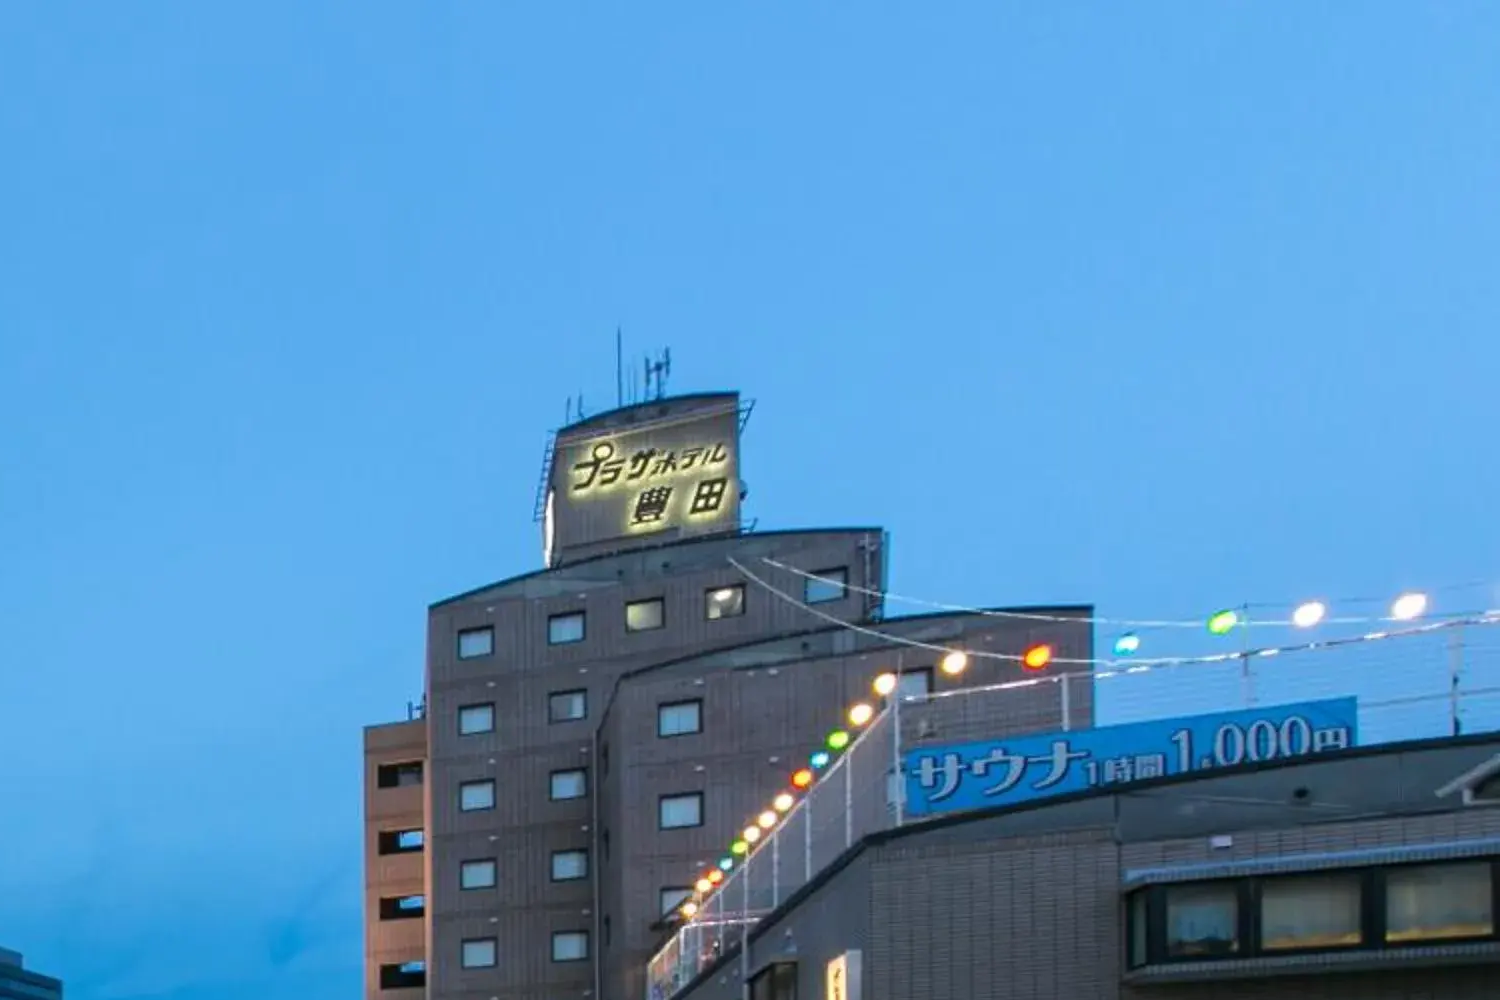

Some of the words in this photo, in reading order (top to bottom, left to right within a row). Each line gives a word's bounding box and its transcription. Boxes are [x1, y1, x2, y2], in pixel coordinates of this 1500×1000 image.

[573, 441, 727, 491] プラザホテル
[630, 477, 728, 526] 豊田
[912, 740, 1088, 803] サウナ
